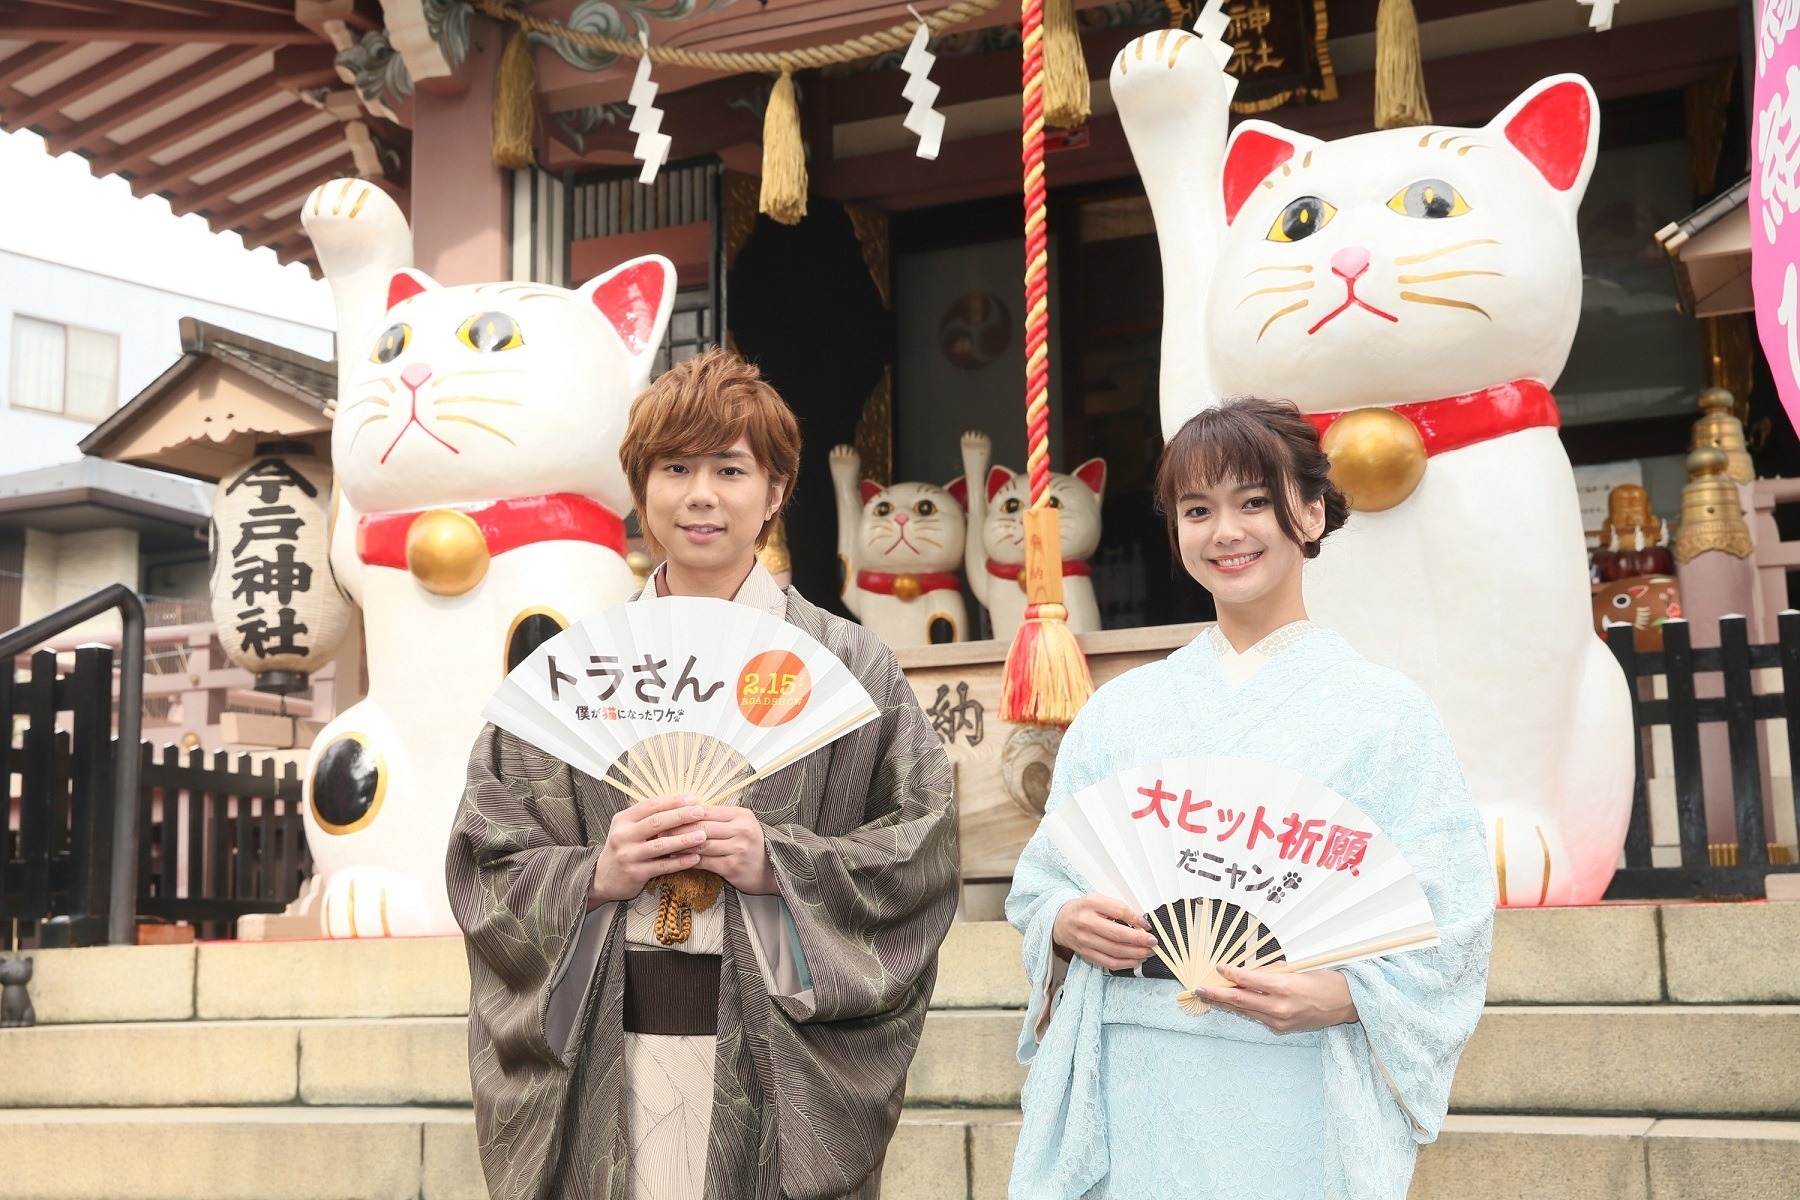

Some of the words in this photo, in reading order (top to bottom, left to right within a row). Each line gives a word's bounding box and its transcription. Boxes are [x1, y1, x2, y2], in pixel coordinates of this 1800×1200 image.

[226, 458, 317, 659] 今戸神社
[547, 653, 725, 705] トラさん
[741, 696, 803, 707] ROADSHOW
[743, 672, 797, 696] 2.15
[576, 705, 676, 723] 僕が猫になったワケ
[926, 681, 985, 748] 納
[1131, 779, 1373, 878] 大ヒット祈願
[1176, 847, 1276, 892] だニャン
